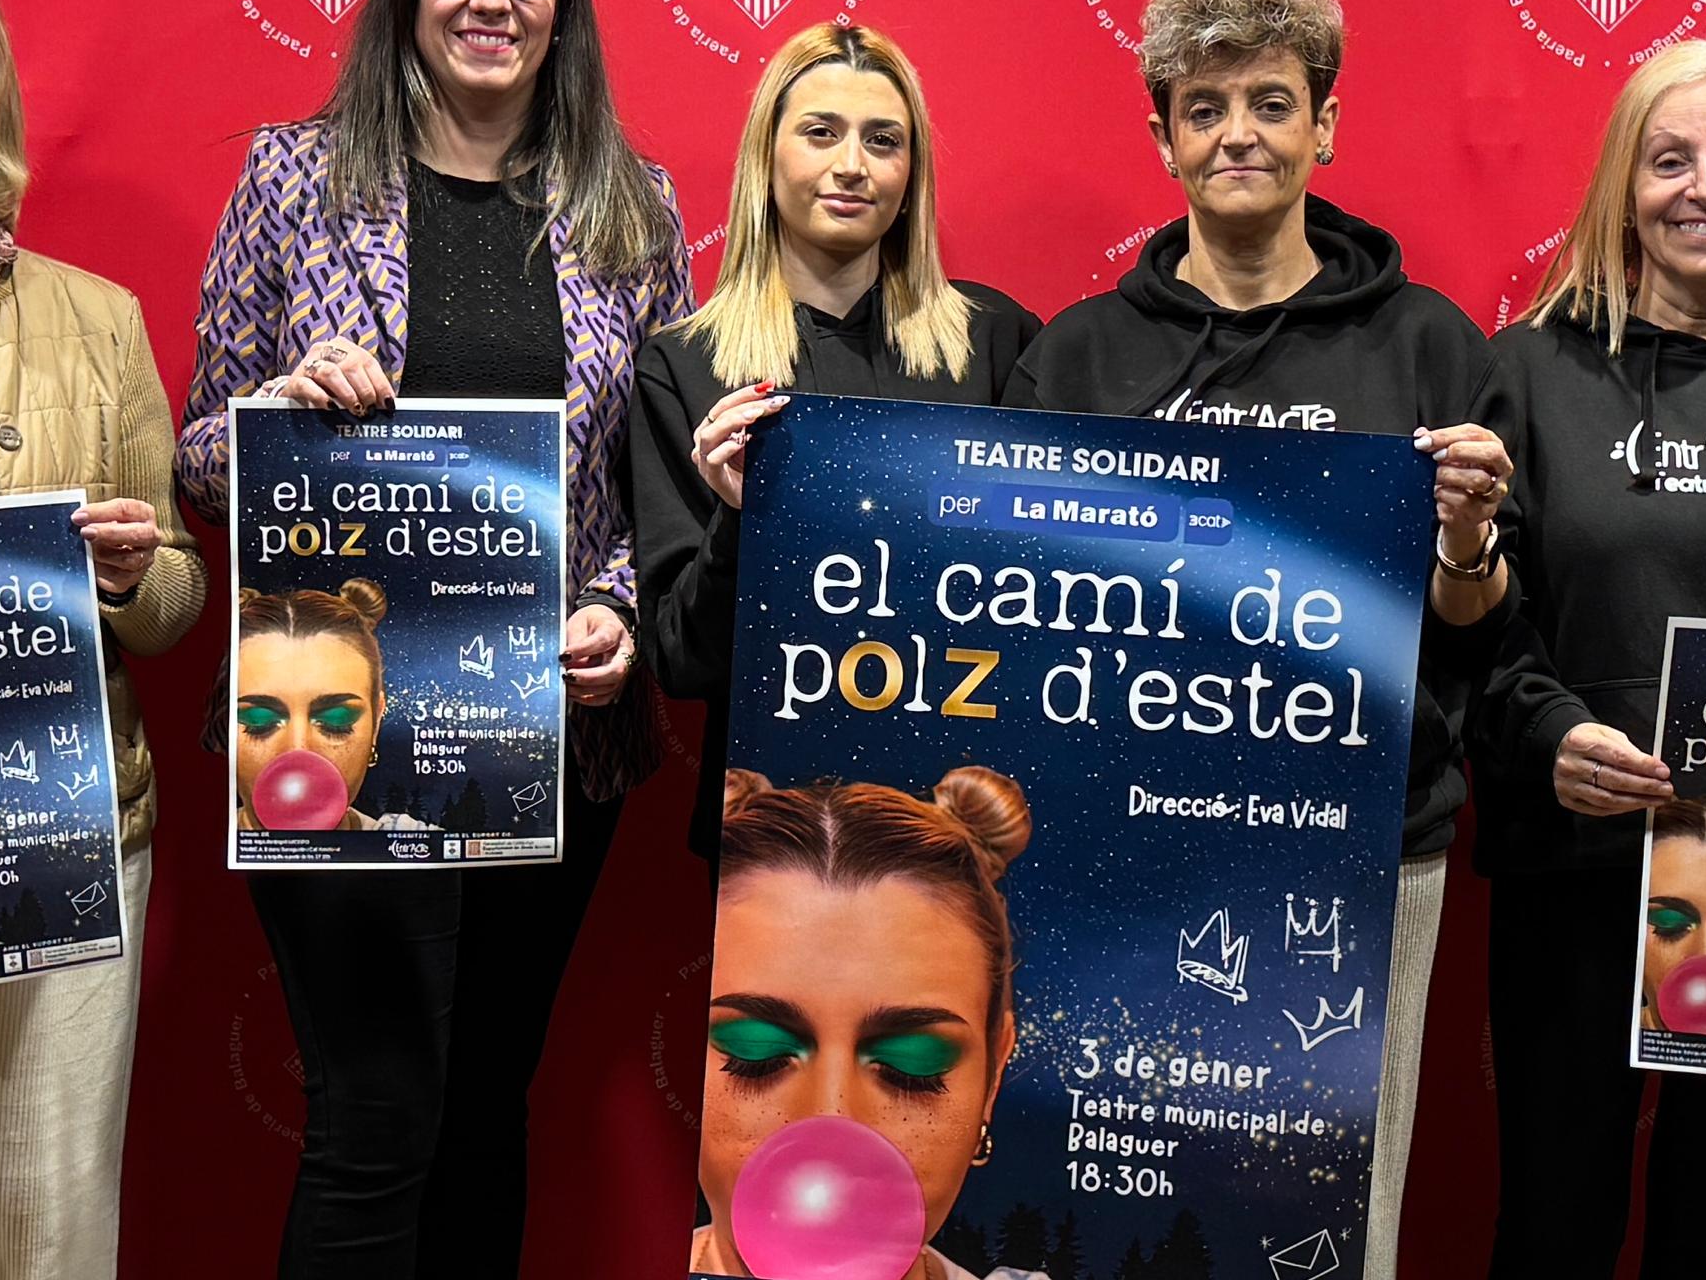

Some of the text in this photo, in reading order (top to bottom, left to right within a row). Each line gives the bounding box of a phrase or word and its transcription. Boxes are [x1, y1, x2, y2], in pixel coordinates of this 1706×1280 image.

[335, 425, 463, 439] TEATRE SOLIDARI
[955, 440, 1219, 482] TEATRE SOLIDARI
[273, 474, 525, 514] el camí de
[940, 496, 980, 517] per
[1014, 497, 1045, 519] La
[1053, 500, 1157, 527] Marató
[258, 517, 542, 563] polz d'estel
[814, 539, 1339, 650] el camí de
[774, 634, 1368, 745] polz d'estel
[1247, 795, 1284, 826] Eva
[1291, 799, 1347, 830] Vidal
[1075, 1039, 1272, 1089] 3 de gener
[1069, 1089, 1326, 1141] Teatre municipal de
[1068, 1123, 1178, 1157] Balaguer
[1067, 1161, 1173, 1196] 18:30h
